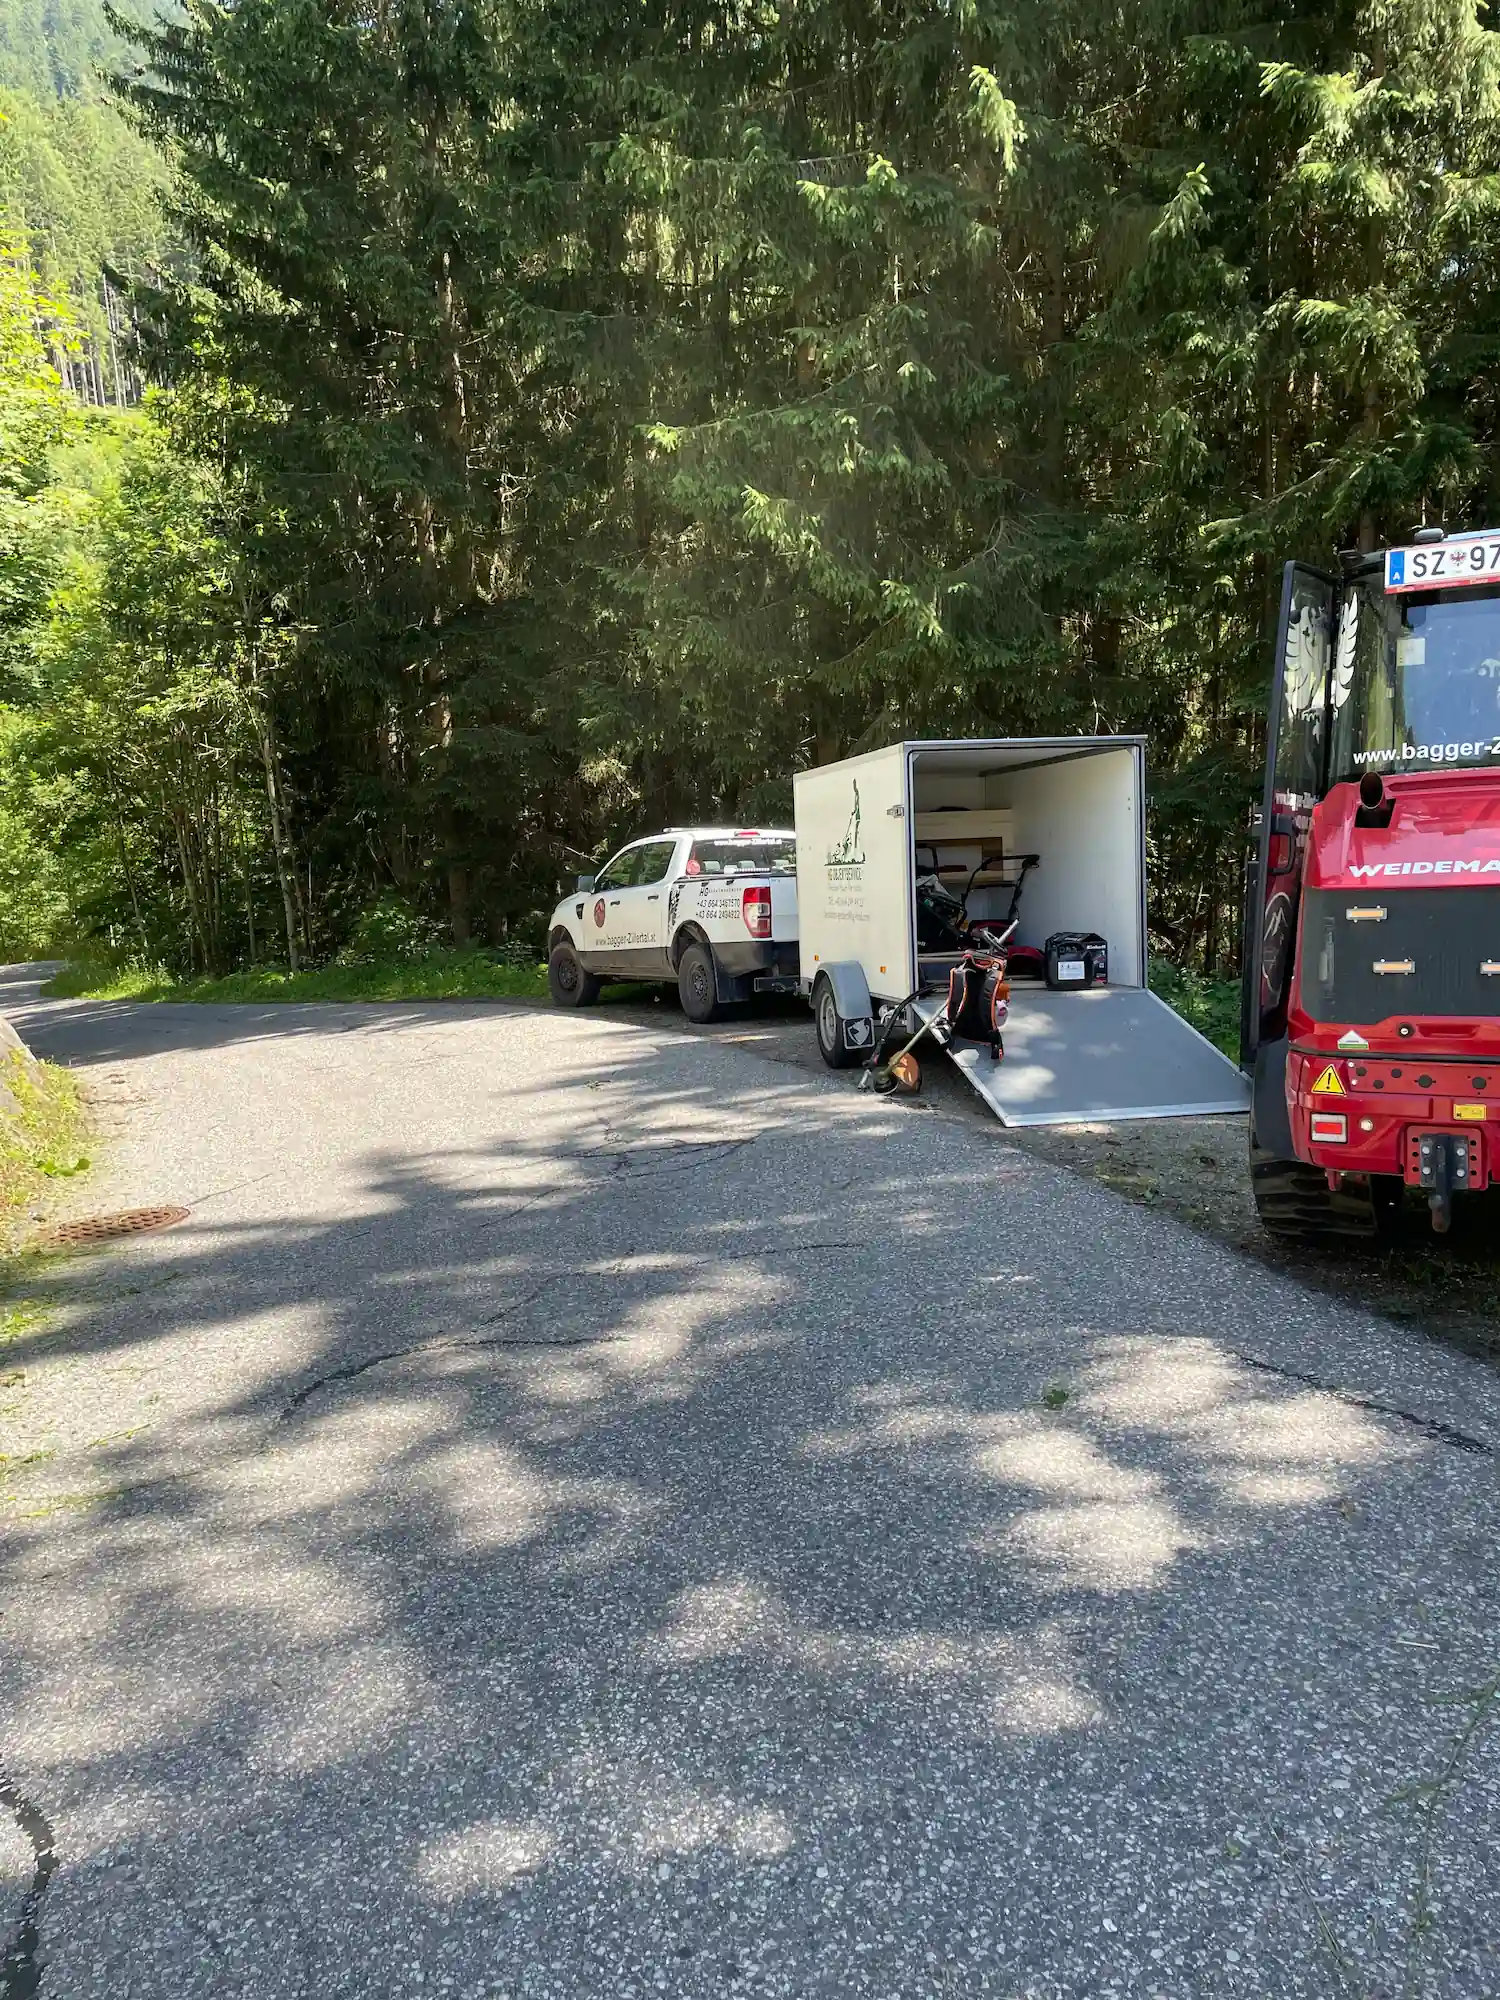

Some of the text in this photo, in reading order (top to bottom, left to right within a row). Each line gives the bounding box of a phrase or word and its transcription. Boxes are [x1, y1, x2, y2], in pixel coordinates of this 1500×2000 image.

[1412, 543, 1500, 578] SZ 97
[1392, 571, 1401, 581] A
